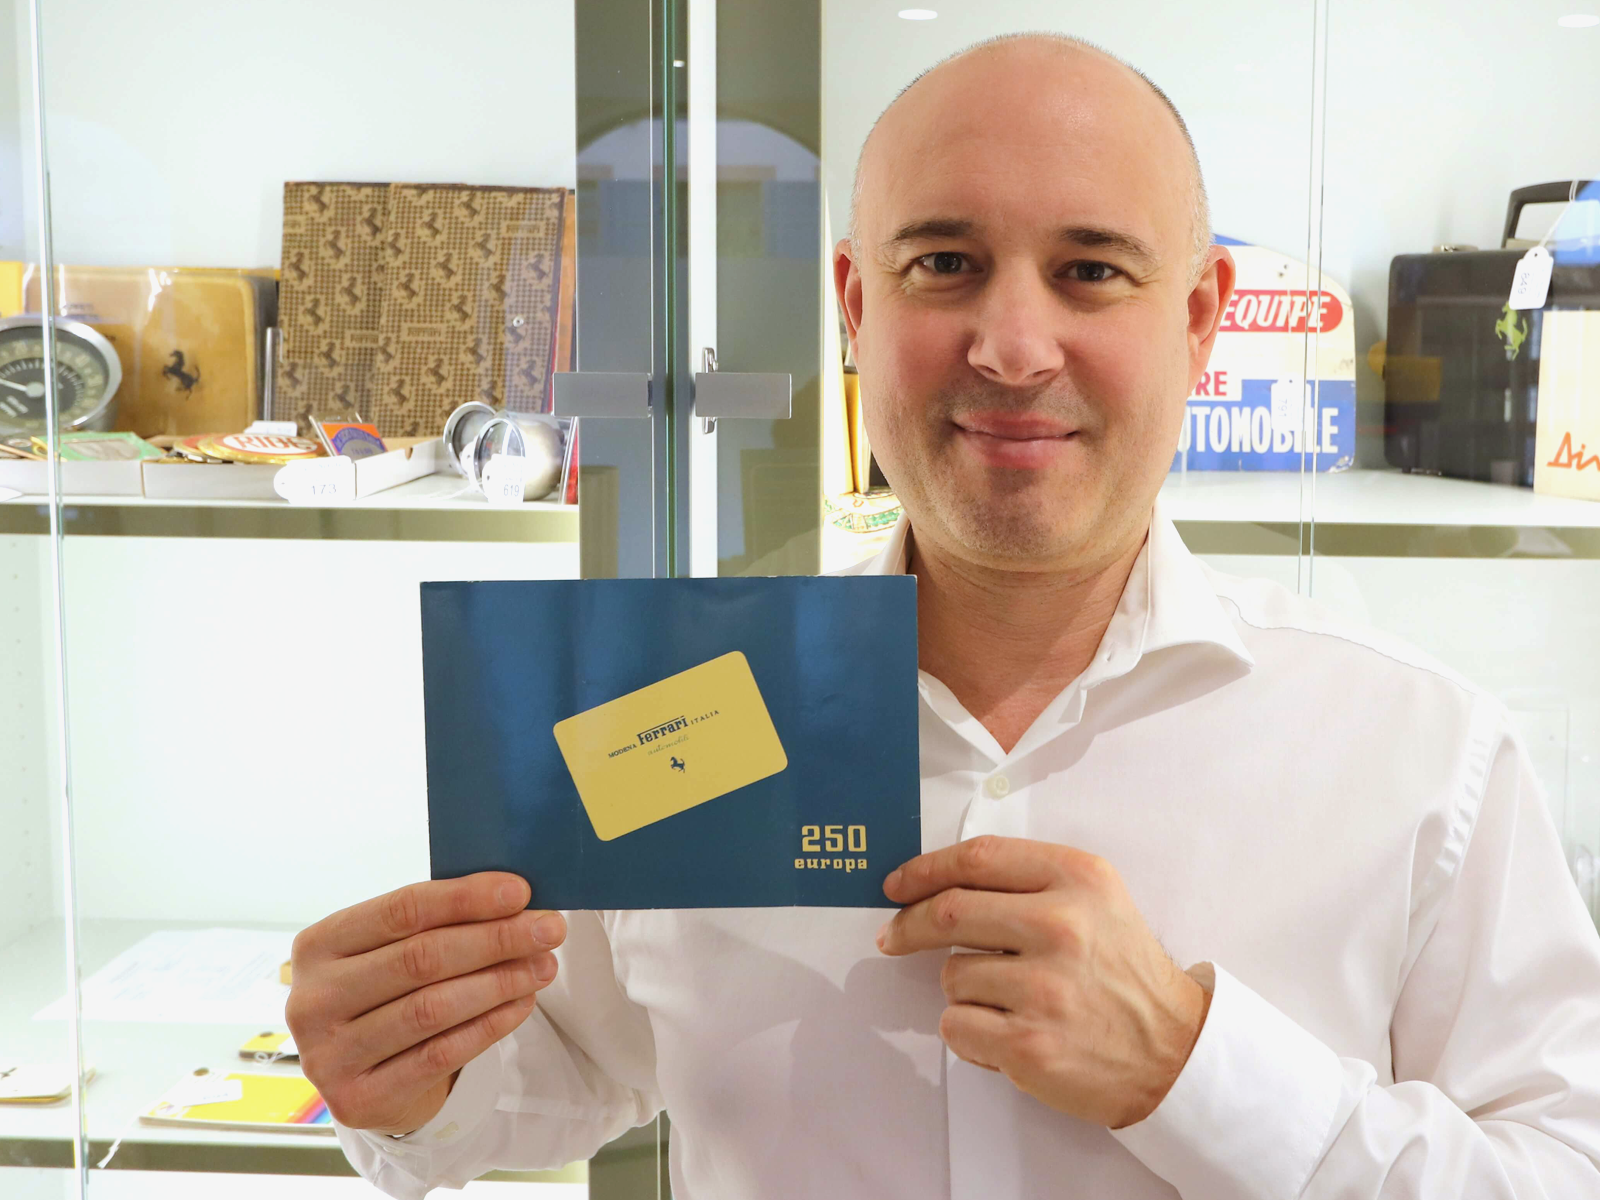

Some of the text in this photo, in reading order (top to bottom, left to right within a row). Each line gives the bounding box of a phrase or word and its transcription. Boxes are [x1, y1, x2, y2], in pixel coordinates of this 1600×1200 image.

[311, 483, 337, 495] 173
[503, 484, 520, 498] 619
[608, 710, 719, 758] MODENA Ferrari ITALIA
[801, 825, 867, 852] 250
[794, 858, 868, 873] europa
